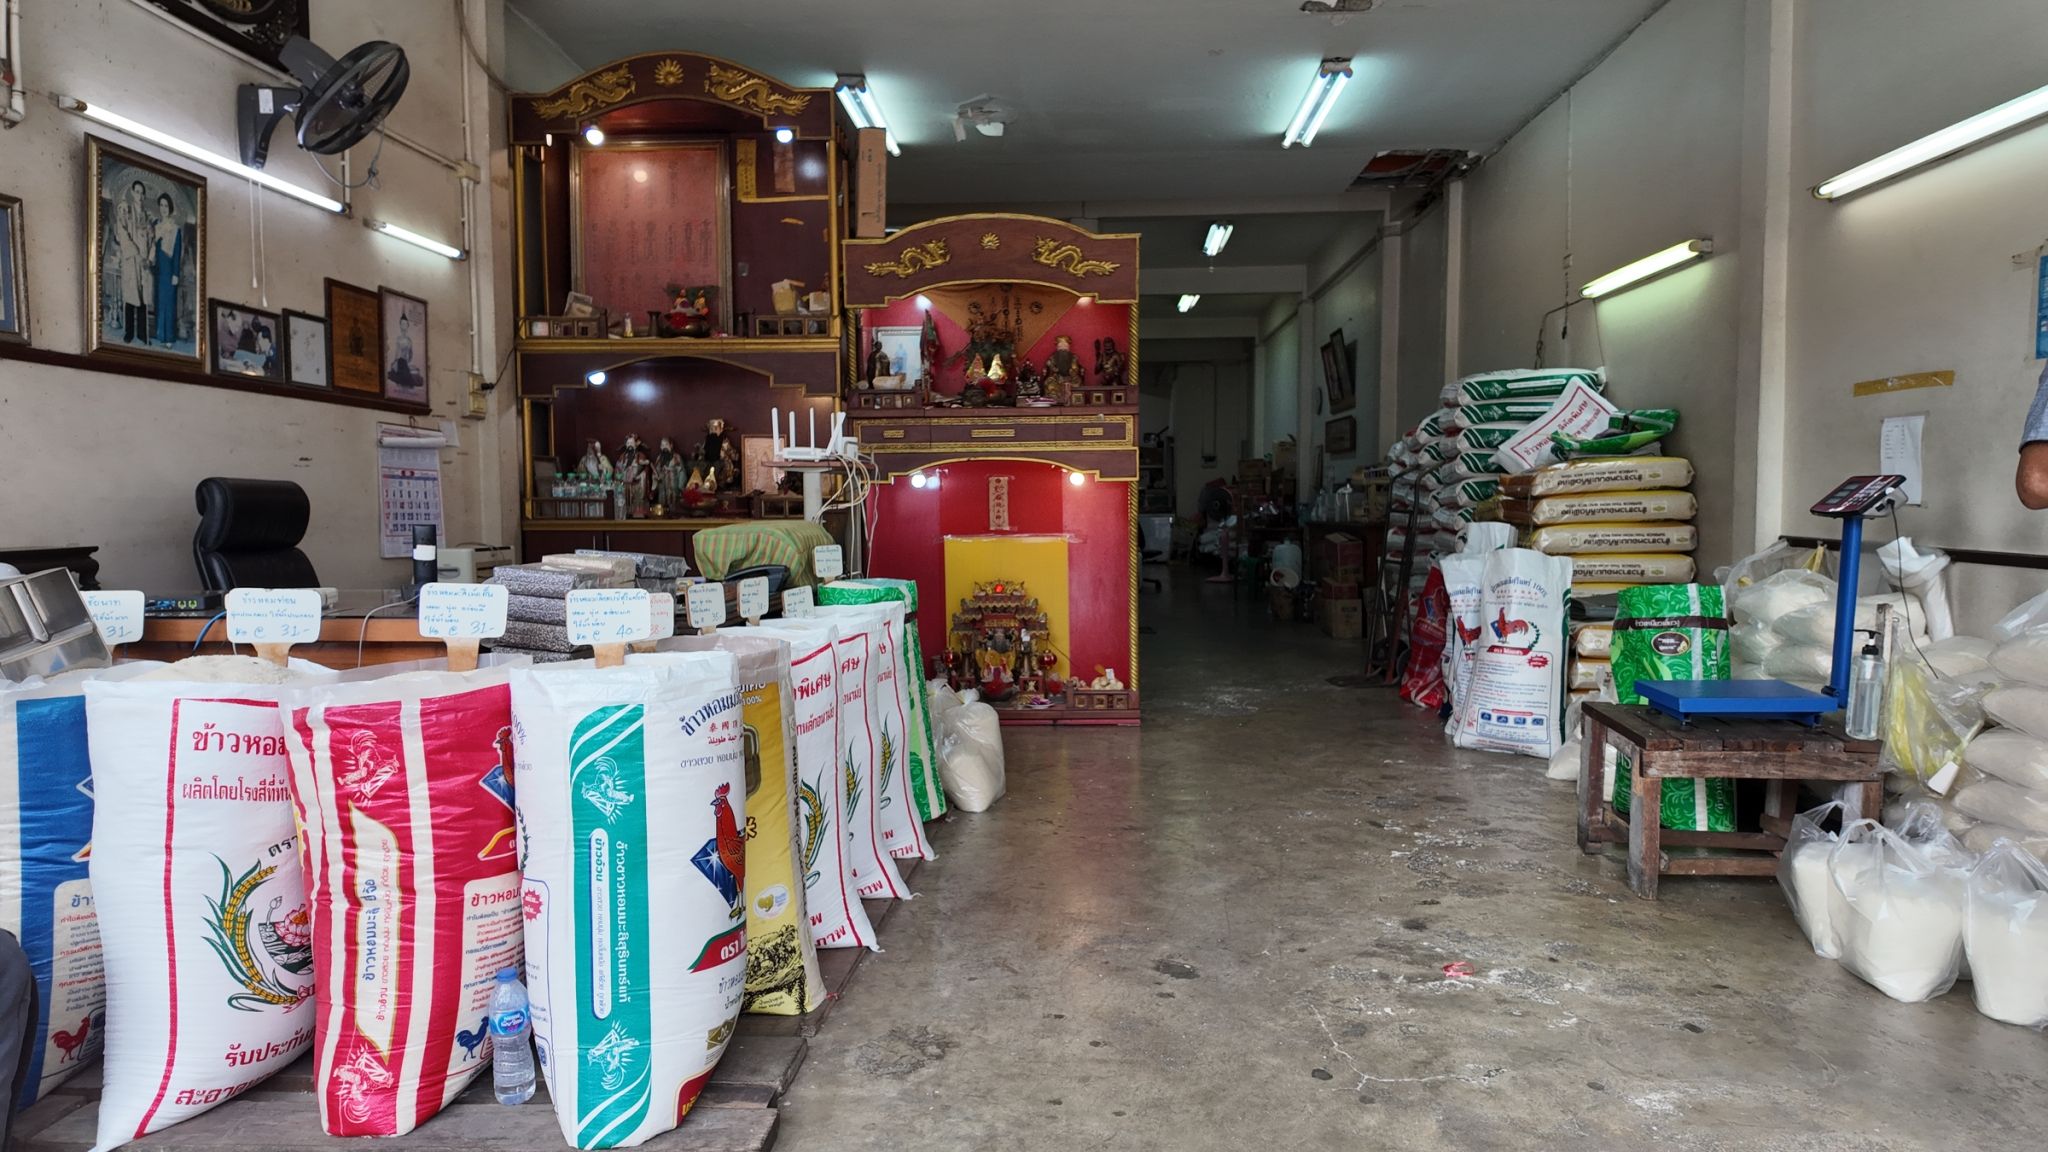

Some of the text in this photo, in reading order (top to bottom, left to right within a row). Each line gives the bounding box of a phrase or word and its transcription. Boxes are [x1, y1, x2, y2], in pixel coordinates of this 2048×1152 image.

[615, 840, 630, 1003] ข้าวขาวหอมมะลิสุรินทร์แท้
